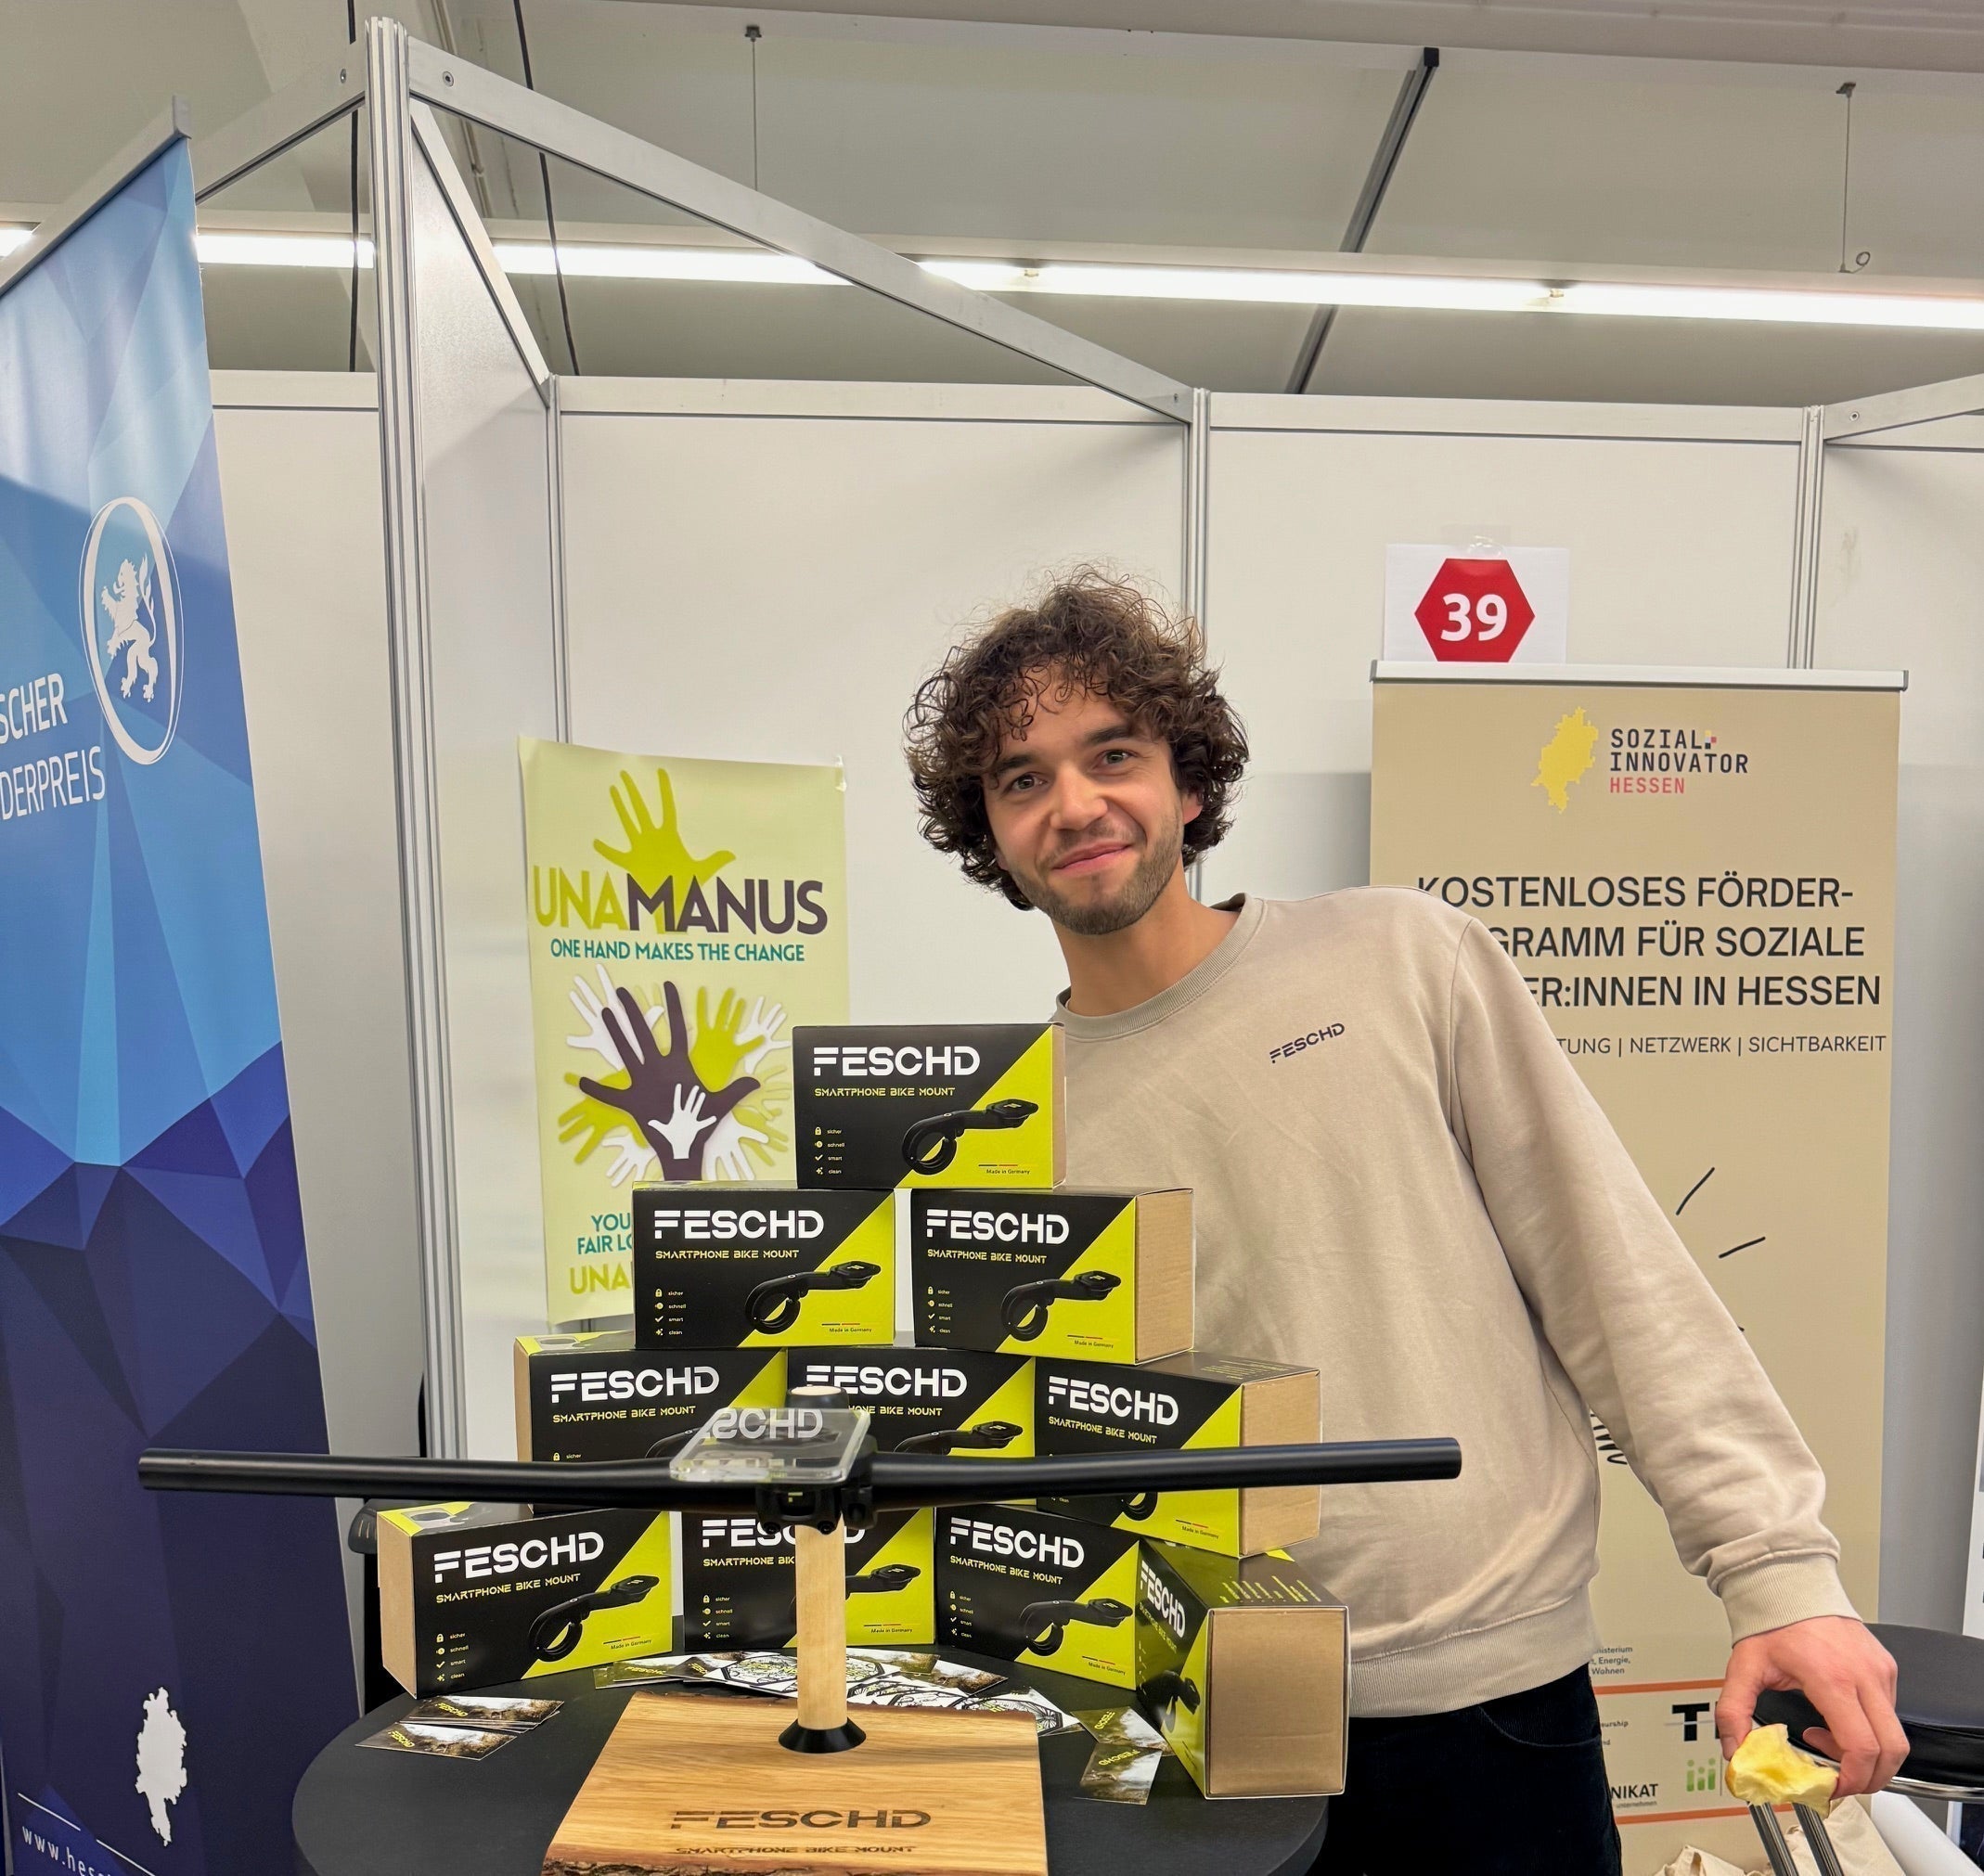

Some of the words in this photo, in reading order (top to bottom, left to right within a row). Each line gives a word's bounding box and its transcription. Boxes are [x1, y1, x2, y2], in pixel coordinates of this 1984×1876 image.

[1439, 593, 1509, 642] 39
[0, 673, 69, 744] SCHER
[1609, 752, 1748, 774] INNOVATOR
[1, 745, 107, 821] DERPREIS
[1609, 777, 1685, 794] HESSEN
[1697, 870, 1854, 908] FÖRDER-
[550, 938, 580, 958] ONE
[584, 940, 630, 960] HAND
[635, 941, 694, 961] MAKES
[698, 943, 730, 961] THE
[734, 943, 805, 962] CHANGE
[1637, 919, 1706, 957] FÜR
[1715, 926, 1865, 957] SOZIALE
[1694, 976, 1725, 1007] IN
[1738, 975, 1881, 1006] HESSEN
[1269, 1022, 1346, 1064] FESCHD
[1630, 1036, 1732, 1054] NETZWERK
[1748, 1035, 1887, 1053] SICHTBARKEIT
[813, 1046, 981, 1077] FESCHD
[814, 1087, 886, 1097] SMARTPHONE
[890, 1087, 915, 1097] BIKE
[919, 1086, 956, 1097] MOUNT
[654, 1210, 825, 1240] FESCHD
[926, 1208, 1070, 1245] FESCHD
[577, 1234, 613, 1255] FAIR
[655, 1250, 729, 1260] SMARTPHONE
[733, 1250, 759, 1259] BIKE
[763, 1249, 800, 1259] MOUNT
[927, 1248, 988, 1262] SMARTPHONE
[990, 1252, 1012, 1263] BIKE
[1014, 1254, 1048, 1265] MOUNT
[550, 1365, 720, 1404] FESCHD
[805, 1365, 968, 1397] FESCHD
[552, 1409, 628, 1423] SMARTPHONE
[631, 1407, 657, 1418] BIKE
[660, 1405, 697, 1416] MOUNT
[879, 1406, 904, 1415] BIKE
[907, 1407, 943, 1417] MOUNT
[1048, 1375, 1179, 1426] FESCHD
[1048, 1416, 1103, 1434] SMARTPHONE
[1105, 1426, 1126, 1438] BIKE
[1127, 1431, 1158, 1445] MOUNT
[702, 1518, 866, 1548] FESD
[949, 1516, 1085, 1569] FESCHD
[433, 1531, 605, 1584] FESCHD
[702, 1556, 775, 1567] SMARTPHONE
[949, 1555, 1007, 1574] SMARTPHONE
[1009, 1566, 1030, 1579] BIKE
[1032, 1571, 1063, 1586] MOUNT
[435, 1583, 512, 1604] SMARTPHONE
[515, 1579, 542, 1592] BIKE
[545, 1573, 582, 1587] MOUNT
[1140, 1559, 1186, 1638] FESCHD
[670, 1809, 933, 1831] FESCHD
[21, 1825, 111, 1876] www.hes
[675, 1846, 798, 1856] SMARTPHONE
[854, 1845, 913, 1854] MOUNT
